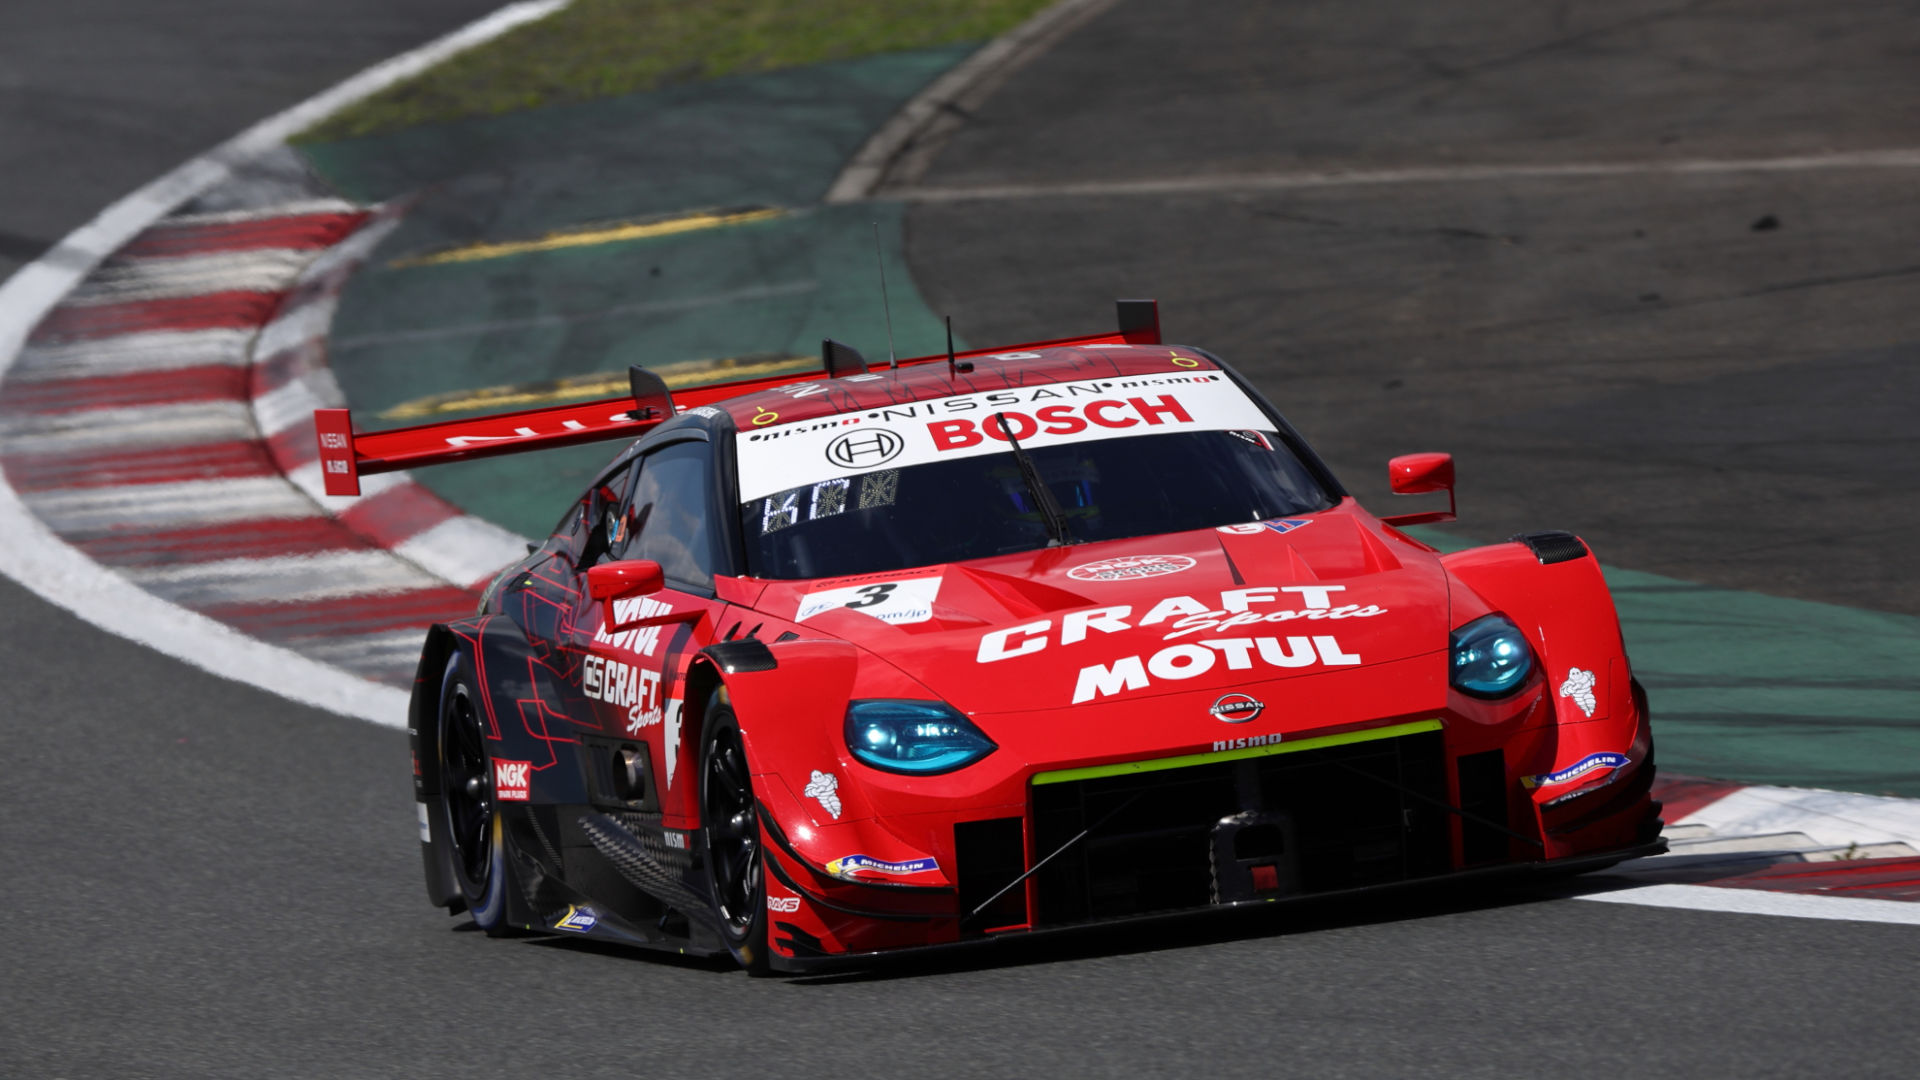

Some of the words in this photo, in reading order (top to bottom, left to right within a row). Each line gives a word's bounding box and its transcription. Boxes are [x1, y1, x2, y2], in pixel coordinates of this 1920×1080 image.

[1122, 376, 1210, 389] nismo
[883, 383, 1101, 421] NISSAN
[763, 418, 860, 441] nismo
[926, 394, 1195, 452] BOSCH
[320, 433, 348, 448] NISSAN
[1085, 558, 1168, 573] NGK
[845, 583, 898, 609] 3
[594, 597, 673, 657] MOTUL
[976, 585, 1346, 663] CRAFT
[1163, 603, 1388, 640] Sports
[1072, 635, 1361, 704] MOTUL
[604, 659, 661, 711] CRAFT
[626, 705, 662, 736] Sports
[1210, 702, 1265, 715] NISSAN
[1213, 733, 1282, 752] nismo
[497, 763, 528, 788] NGK
[1554, 756, 1617, 782] MICHELIN
[860, 858, 924, 872] MICHELIN
